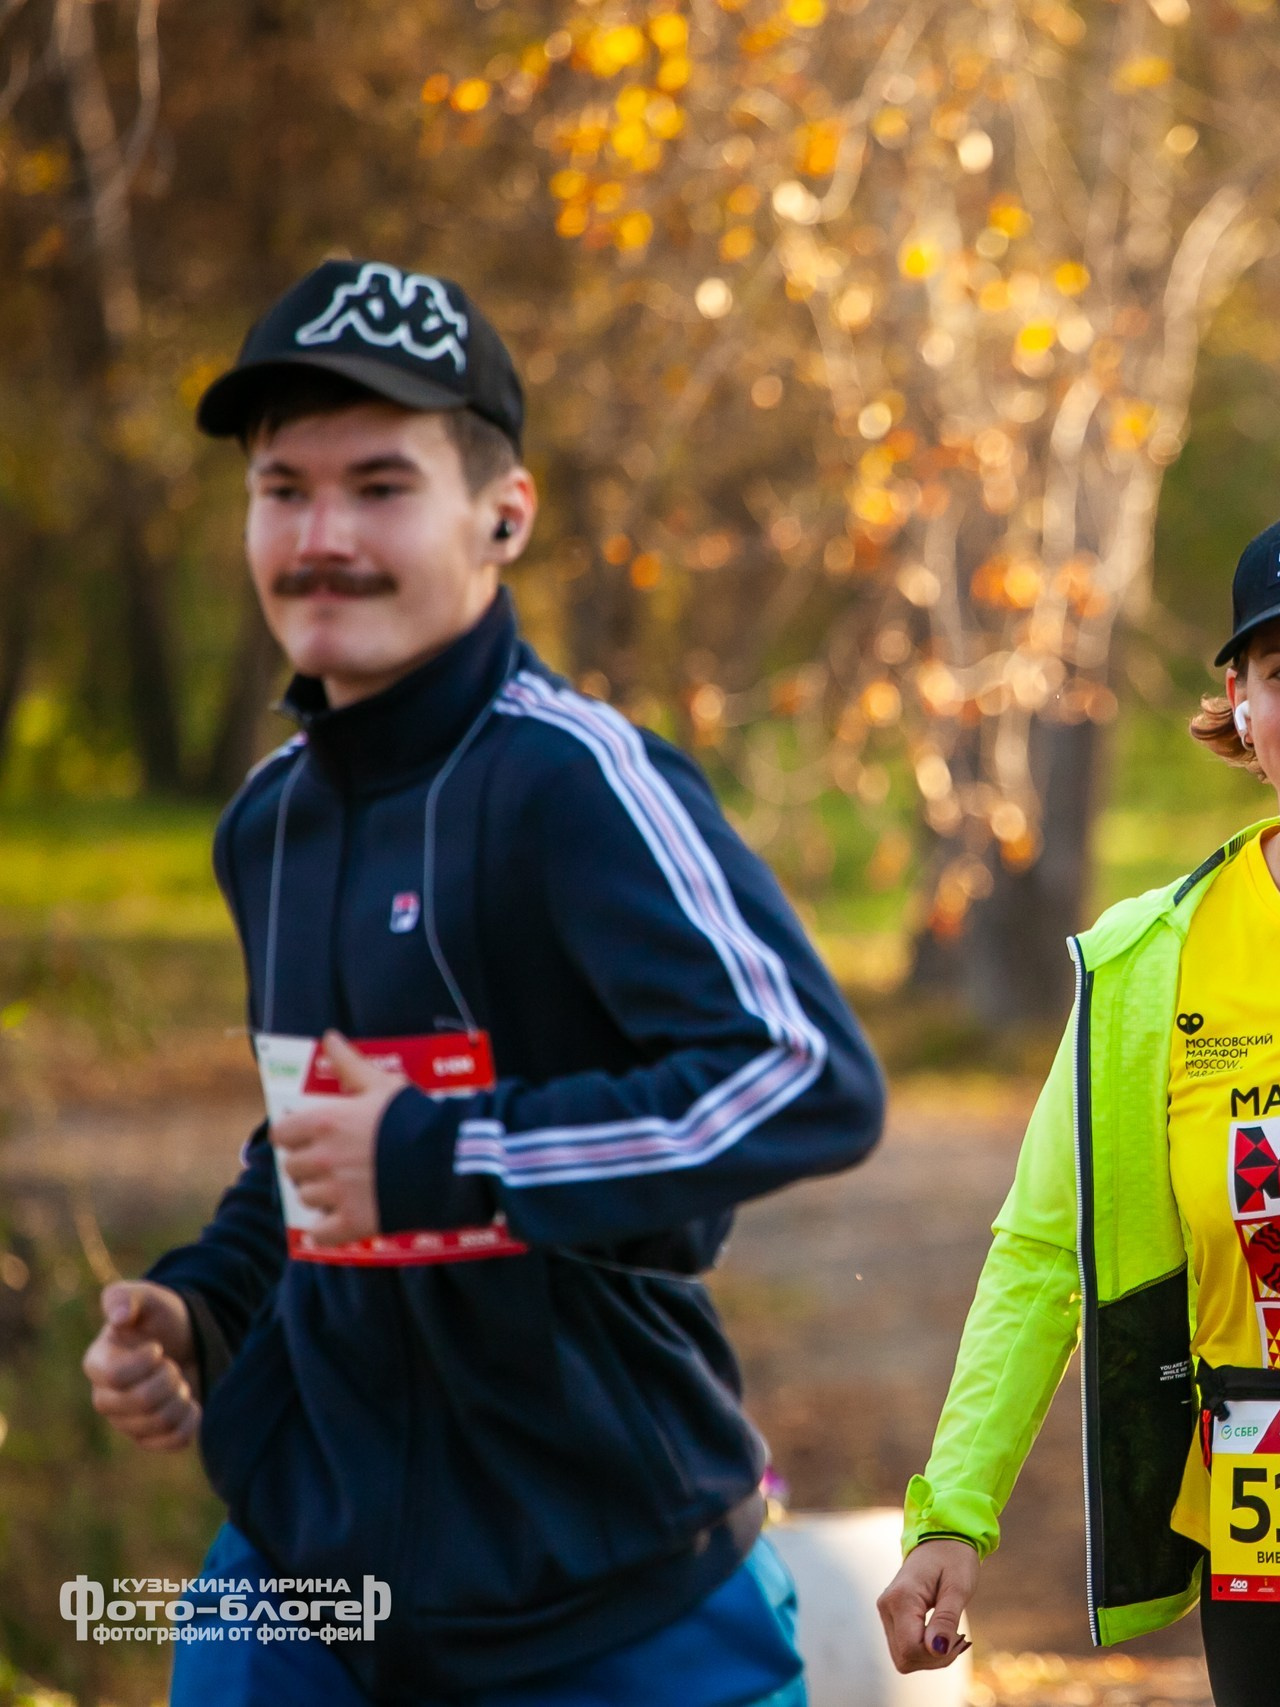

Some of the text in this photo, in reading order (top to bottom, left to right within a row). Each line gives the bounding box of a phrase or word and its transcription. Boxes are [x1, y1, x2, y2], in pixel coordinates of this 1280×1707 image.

[1185, 1033, 1273, 1048] МОСКОВСКИЙ
[1186, 1048, 1248, 1058] МАРАФОН
[1234, 1427, 1259, 1437] СБЕР
